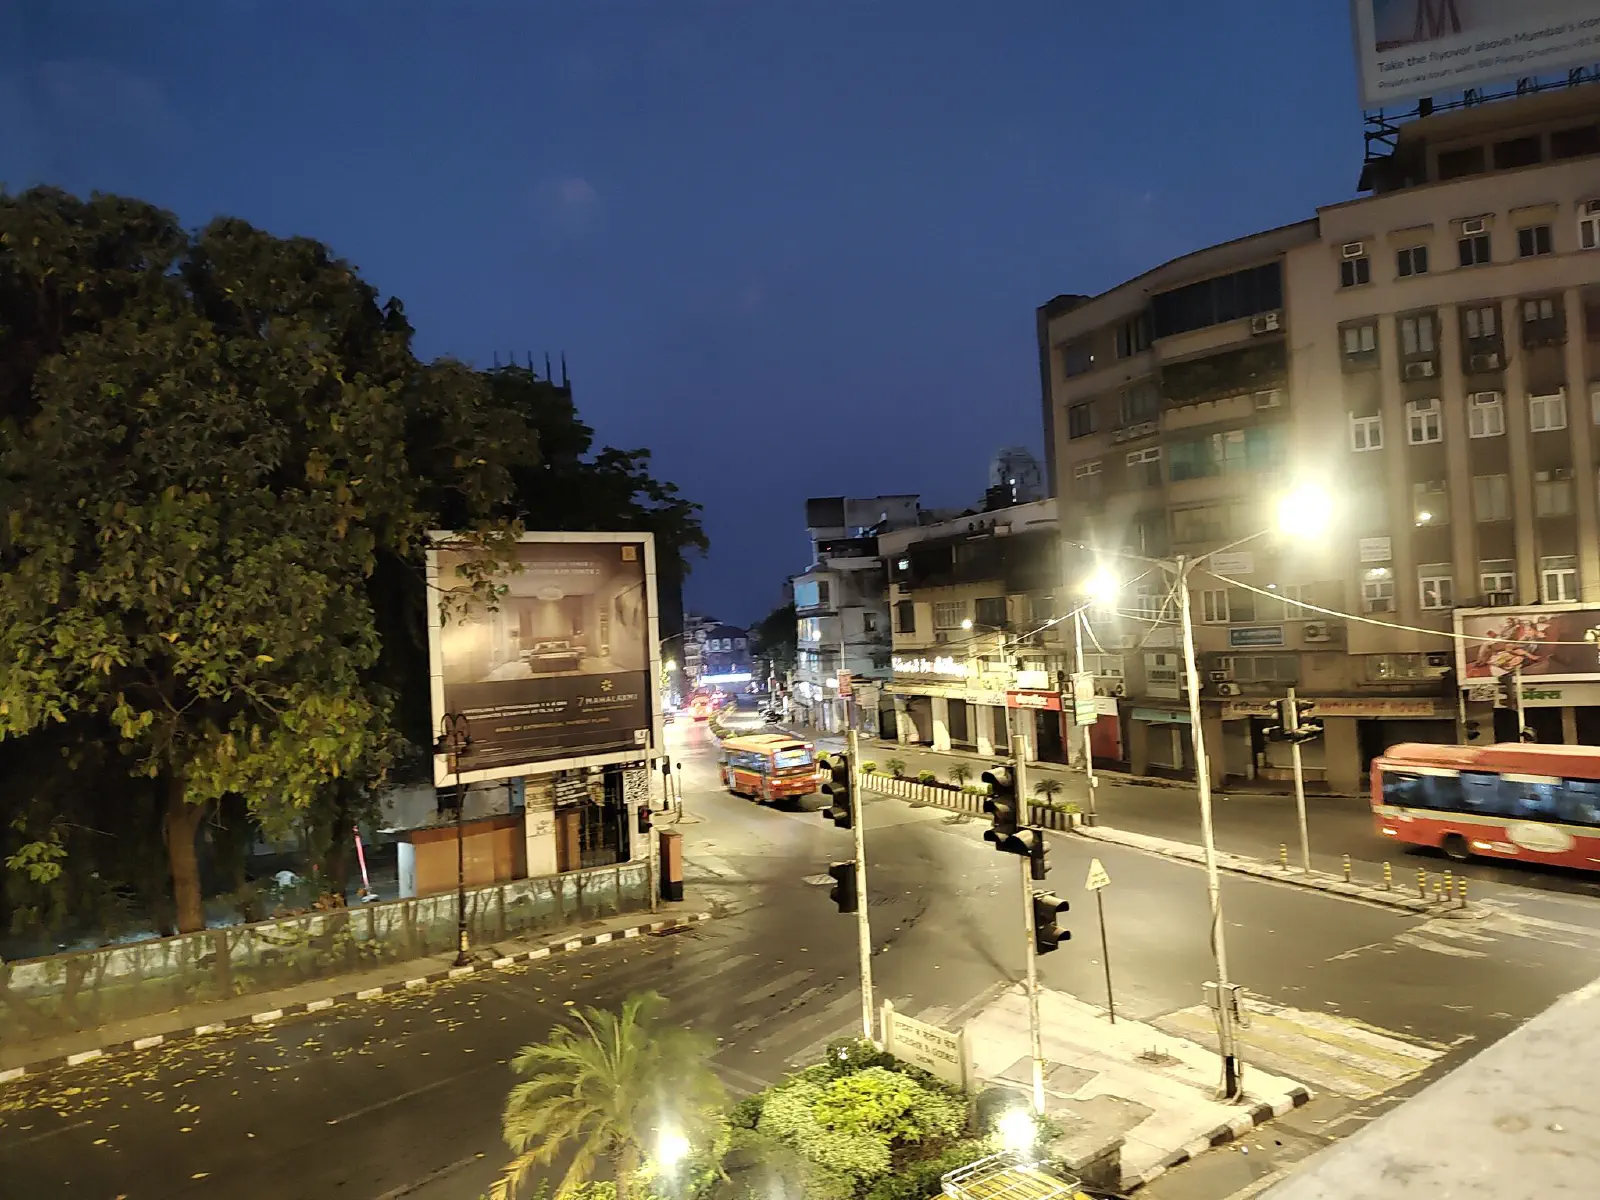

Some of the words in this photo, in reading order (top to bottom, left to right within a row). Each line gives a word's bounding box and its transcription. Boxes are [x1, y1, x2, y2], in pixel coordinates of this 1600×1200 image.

[1377, 60, 1405, 73] Take
[1407, 54, 1427, 67] the
[1429, 45, 1473, 61] flyover
[1474, 37, 1511, 52] above
